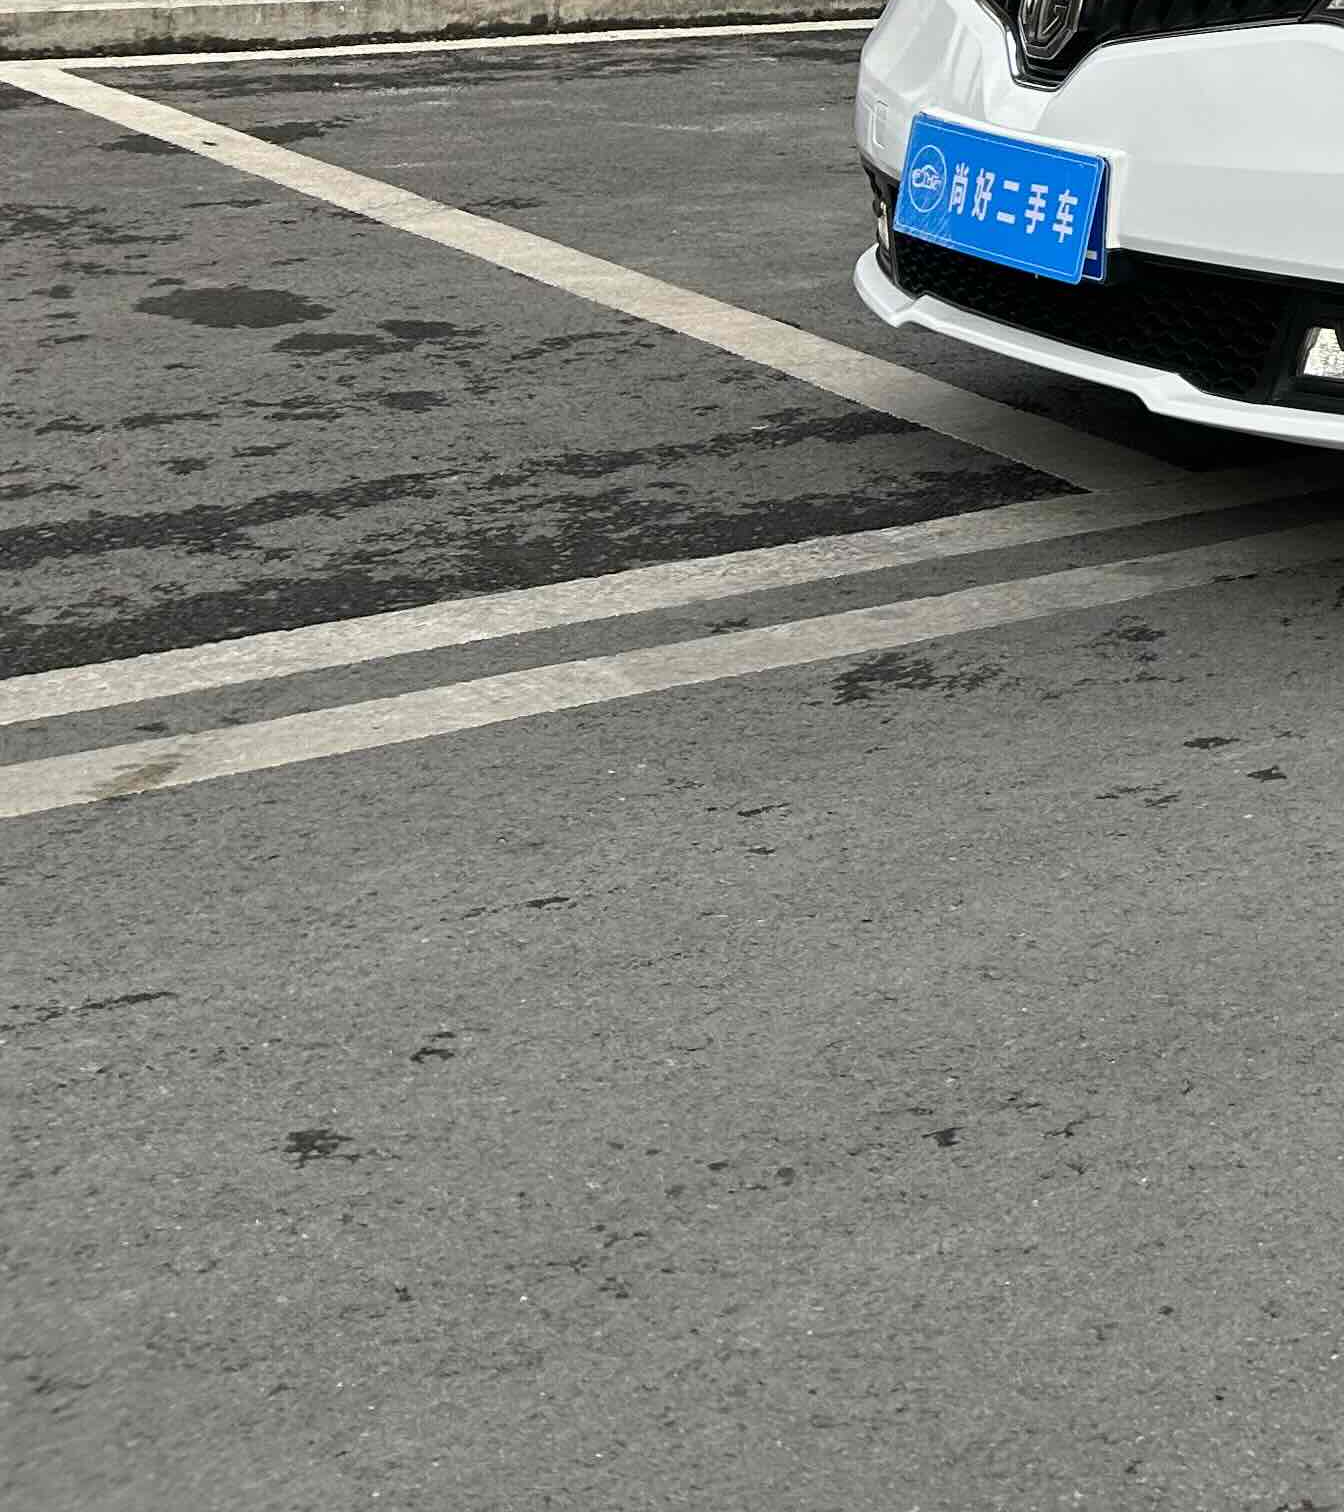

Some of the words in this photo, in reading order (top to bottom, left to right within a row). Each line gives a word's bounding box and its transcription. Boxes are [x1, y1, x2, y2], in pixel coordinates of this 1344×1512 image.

[948, 162, 1079, 244] 尚好二手车
